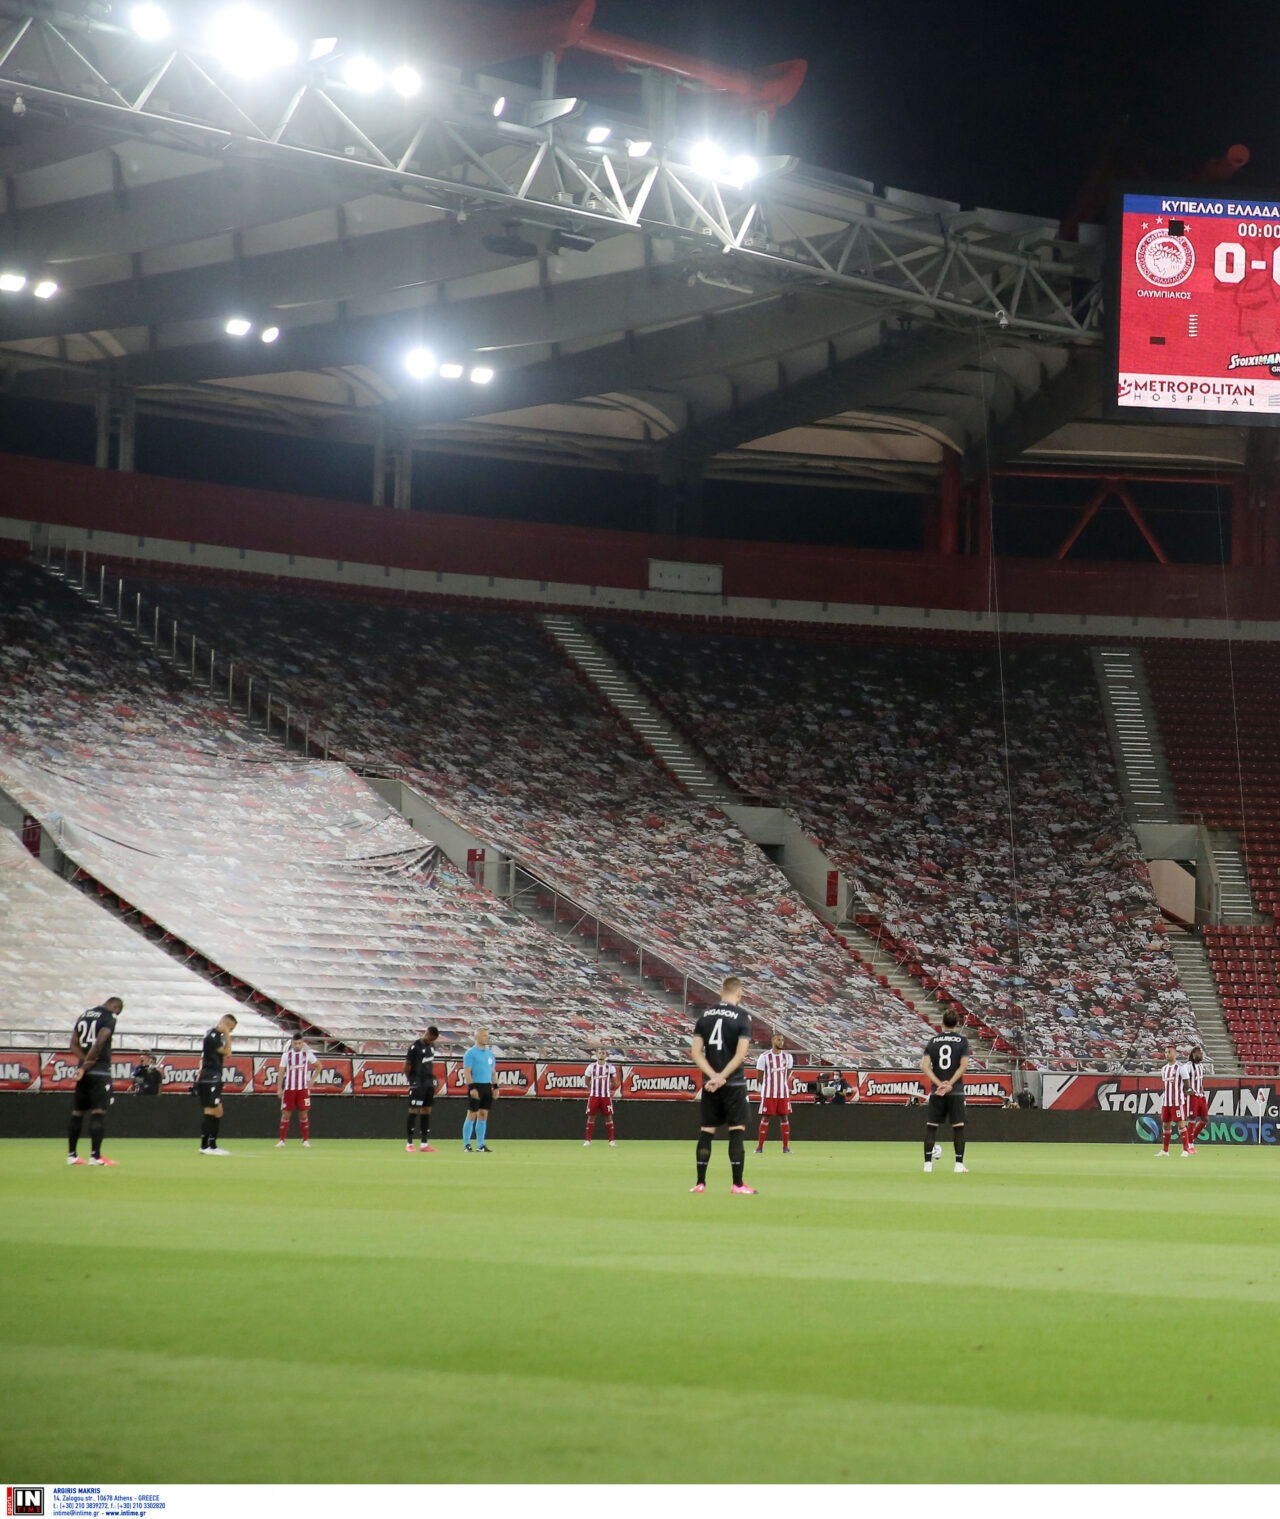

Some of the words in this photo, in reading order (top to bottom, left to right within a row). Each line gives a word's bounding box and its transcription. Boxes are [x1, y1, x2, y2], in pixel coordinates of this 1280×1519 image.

[1162, 200, 1223, 214] ΚΥΠΕΛΛΟ
[1137, 290, 1192, 299] ΟΛΥΜΠΙΑΚΟΣ
[1134, 380, 1254, 396] METROPOLITAN
[1134, 393, 1254, 406] HOSPITAL
[78, 1020, 98, 1048] 24
[709, 1018, 723, 1050] 4
[939, 1044, 952, 1069] 8
[630, 1075, 689, 1092] STOIXIMAN
[866, 1080, 919, 1096] STOIXIMAN
